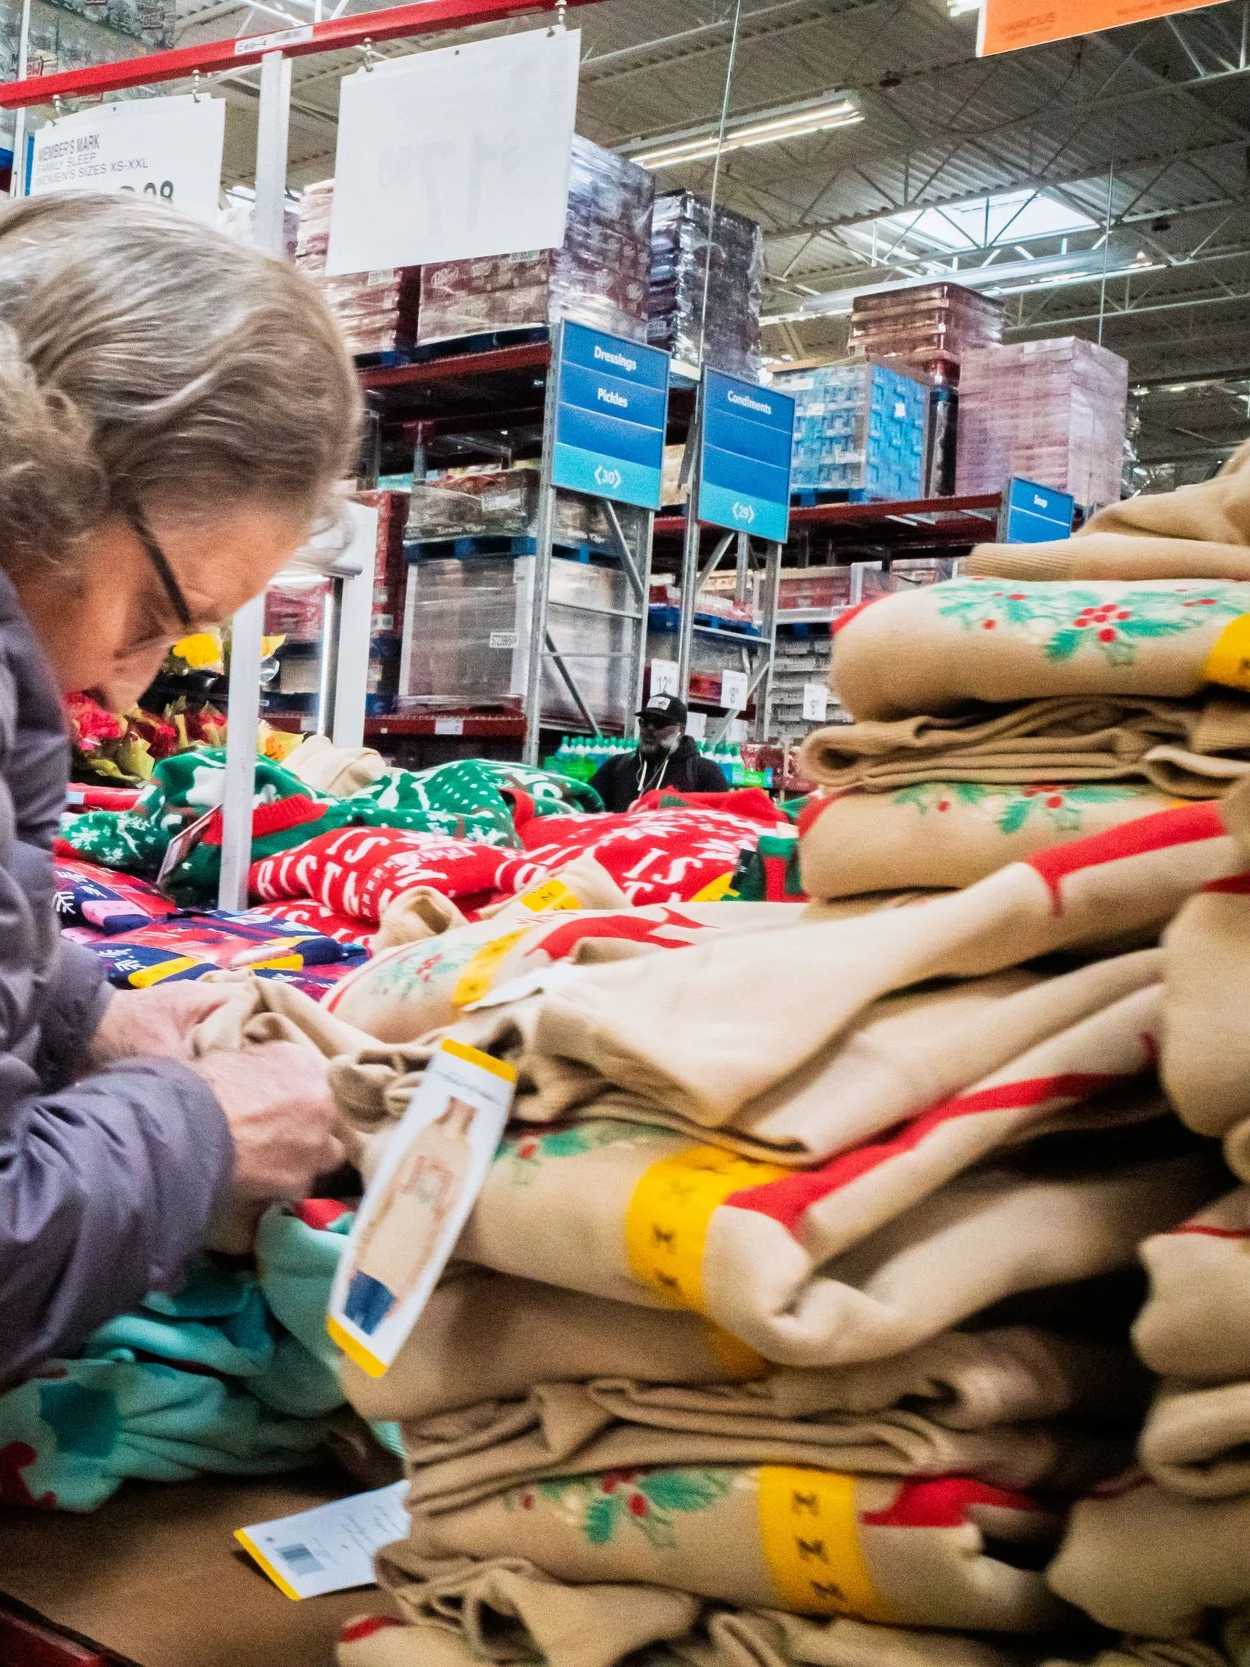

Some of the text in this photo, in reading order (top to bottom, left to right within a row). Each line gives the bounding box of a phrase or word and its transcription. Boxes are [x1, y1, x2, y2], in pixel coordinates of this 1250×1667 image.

[38, 134, 100, 161] MEMBER'S MARK
[66, 153, 97, 167] SLEEP
[78, 163, 107, 179] SIZES
[110, 158, 149, 172] XS-XXL
[593, 346, 637, 372] Dressings
[597, 388, 628, 408] Pickles
[727, 391, 772, 415] Condiments
